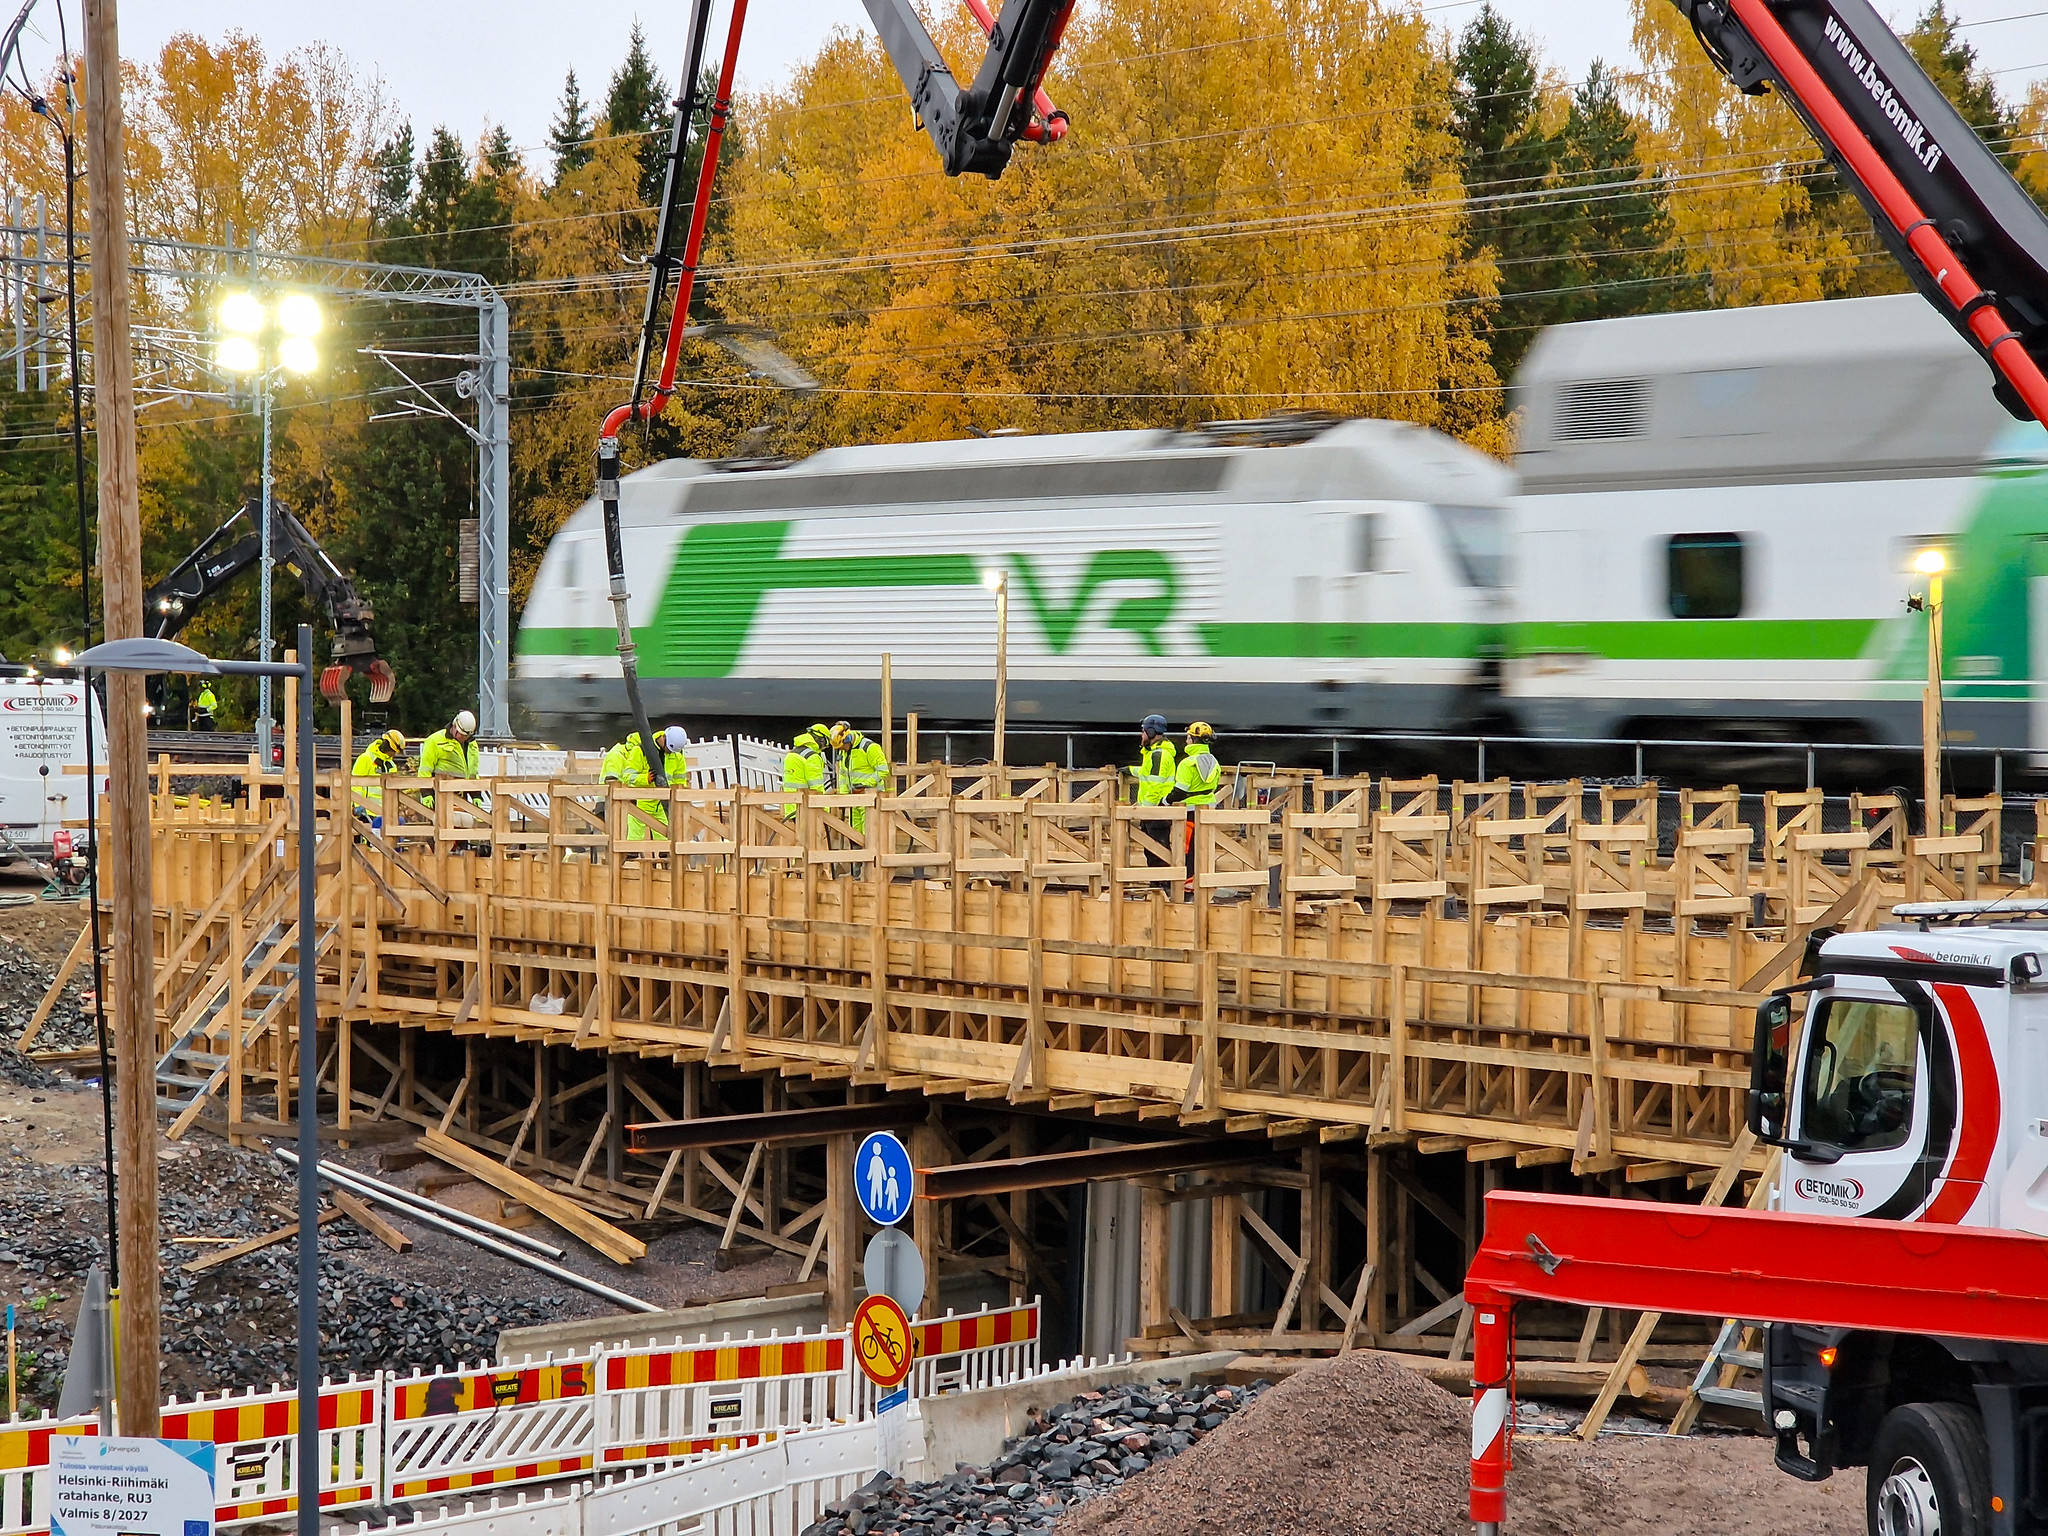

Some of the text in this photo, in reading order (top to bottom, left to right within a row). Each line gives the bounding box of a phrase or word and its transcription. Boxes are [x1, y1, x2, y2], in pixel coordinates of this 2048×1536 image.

[1824, 15, 1943, 174] www.betomik.fi
[1008, 549, 1179, 656] VR
[18, 697, 65, 706] BETOMIK
[1806, 1179, 1850, 1199] BETOMIK
[1818, 1196, 1839, 1206] 050-50
[1848, 1202, 1860, 1210] 507
[495, 1383, 519, 1394] KREATE
[713, 1403, 739, 1414] KREATE
[59, 1462, 86, 1470] Tulossa
[236, 1465, 263, 1475] KREATE
[58, 1474, 169, 1489] Helsinki-Riihimäki
[58, 1490, 152, 1504] ratahanke, RU3
[59, 1508, 148, 1521] Valmis 8/2027
